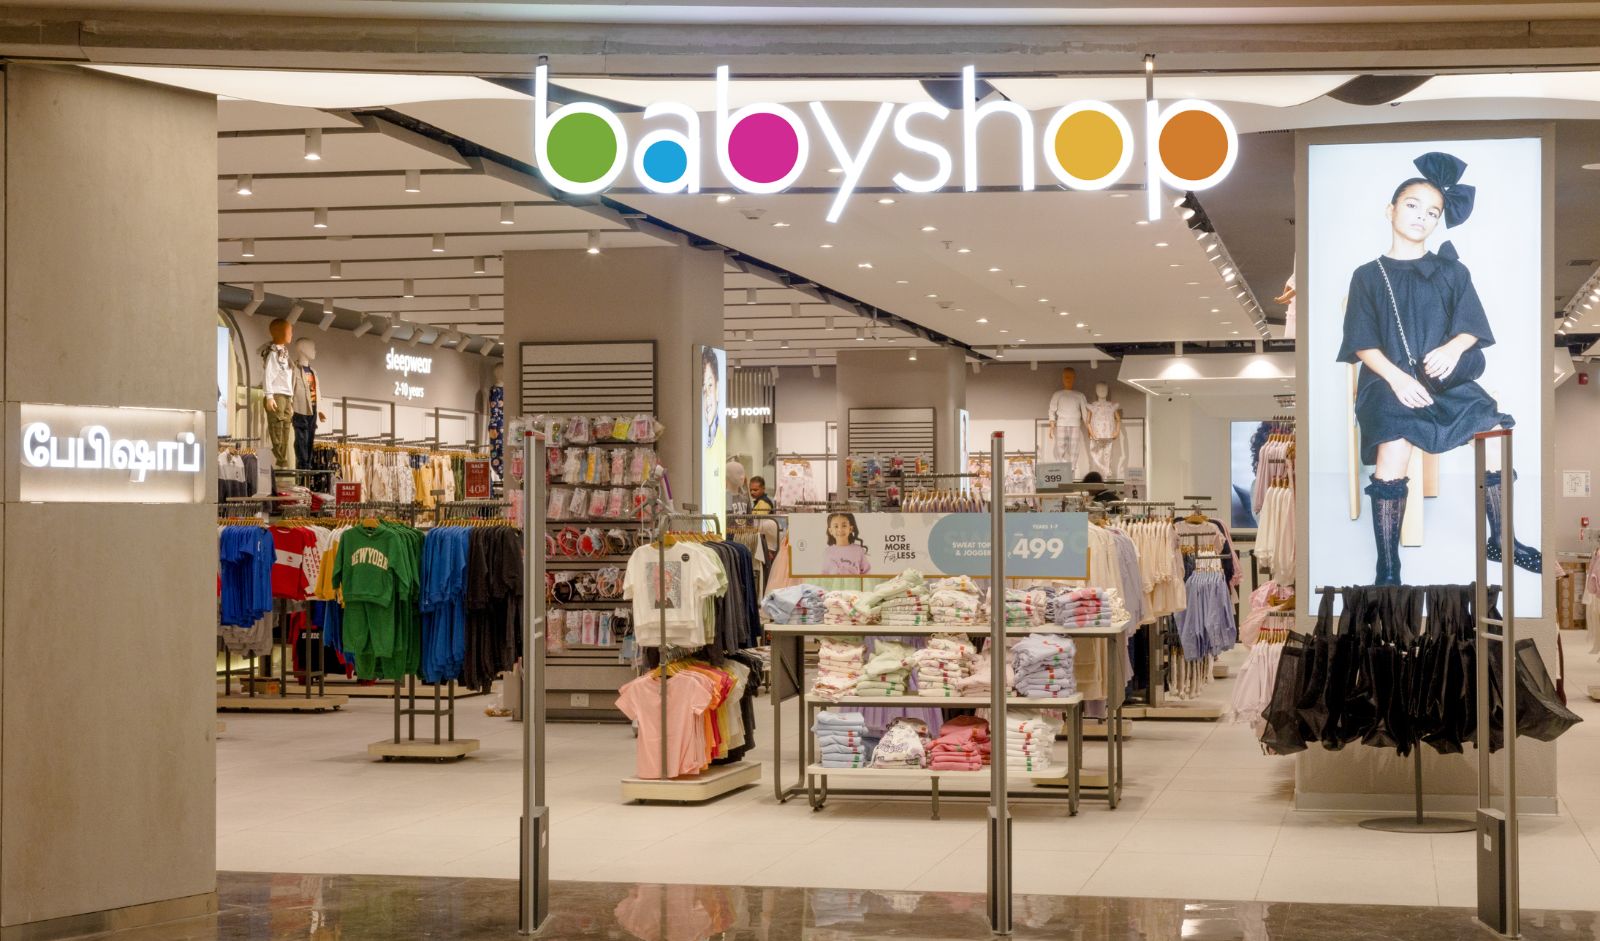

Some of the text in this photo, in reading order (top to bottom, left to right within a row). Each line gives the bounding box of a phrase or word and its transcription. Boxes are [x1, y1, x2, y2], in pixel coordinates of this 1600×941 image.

[535, 64, 1239, 223] babyshop
[386, 347, 432, 377] sleepwear
[394, 381, 424, 400] 2-10 years
[741, 407, 771, 416] room
[23, 421, 201, 483] பேபிஷாப்
[1044, 474, 1062, 483] 399
[884, 534, 906, 543] LOTS
[884, 543, 911, 551] MORE
[952, 541, 976, 549] SWEAT
[897, 551, 916, 560] LESS
